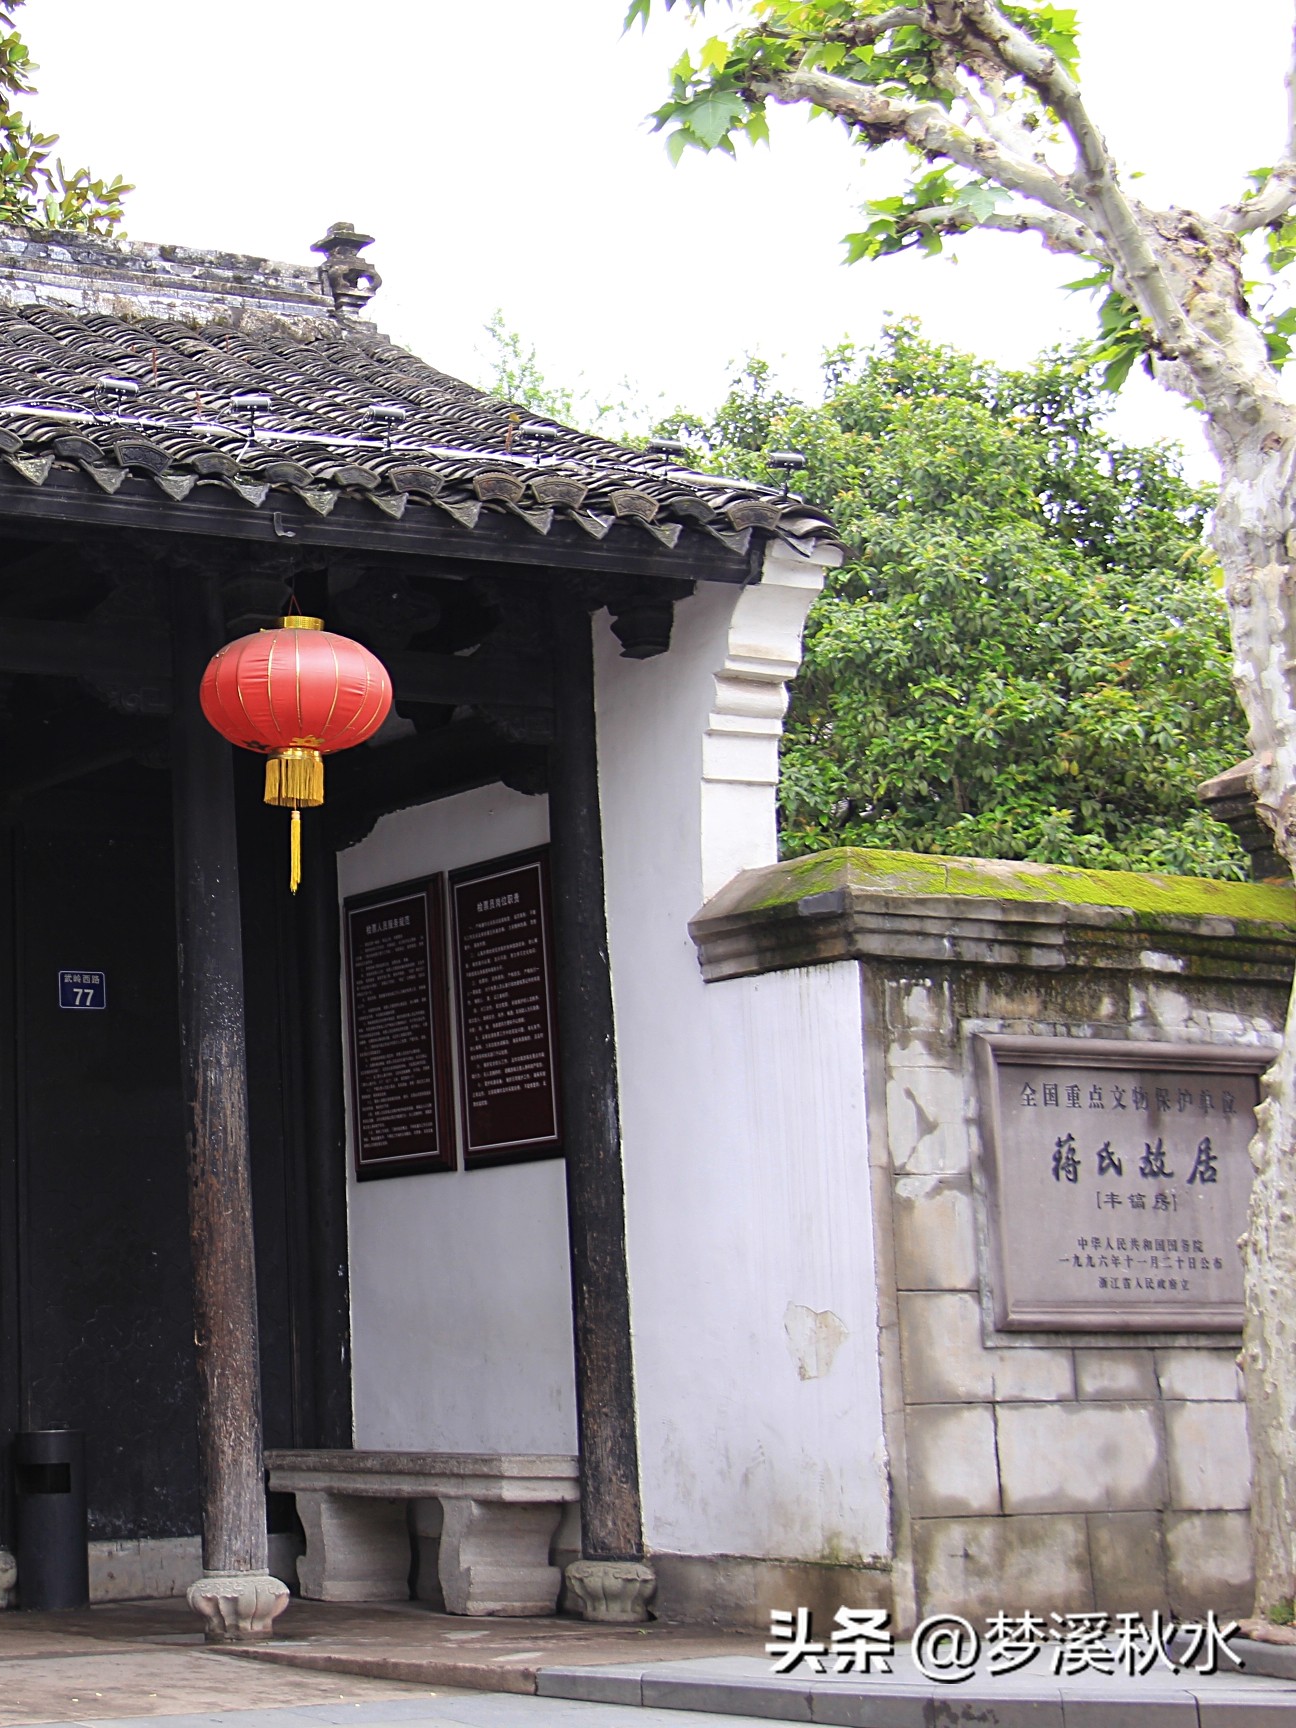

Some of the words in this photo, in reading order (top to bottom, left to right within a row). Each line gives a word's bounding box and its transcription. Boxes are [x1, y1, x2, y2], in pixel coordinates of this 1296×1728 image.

[64, 973, 100, 985] 武岭西路
[73, 988, 94, 1006] 77
[1020, 1081, 1237, 1115] 全国重点文物保护单位
[1051, 1132, 1219, 1185] 蒋氏故居
[1077, 1236, 1204, 1253] 中华人民共和国国务院
[1059, 1254, 1223, 1270] 一九九六年十一月二十日公布
